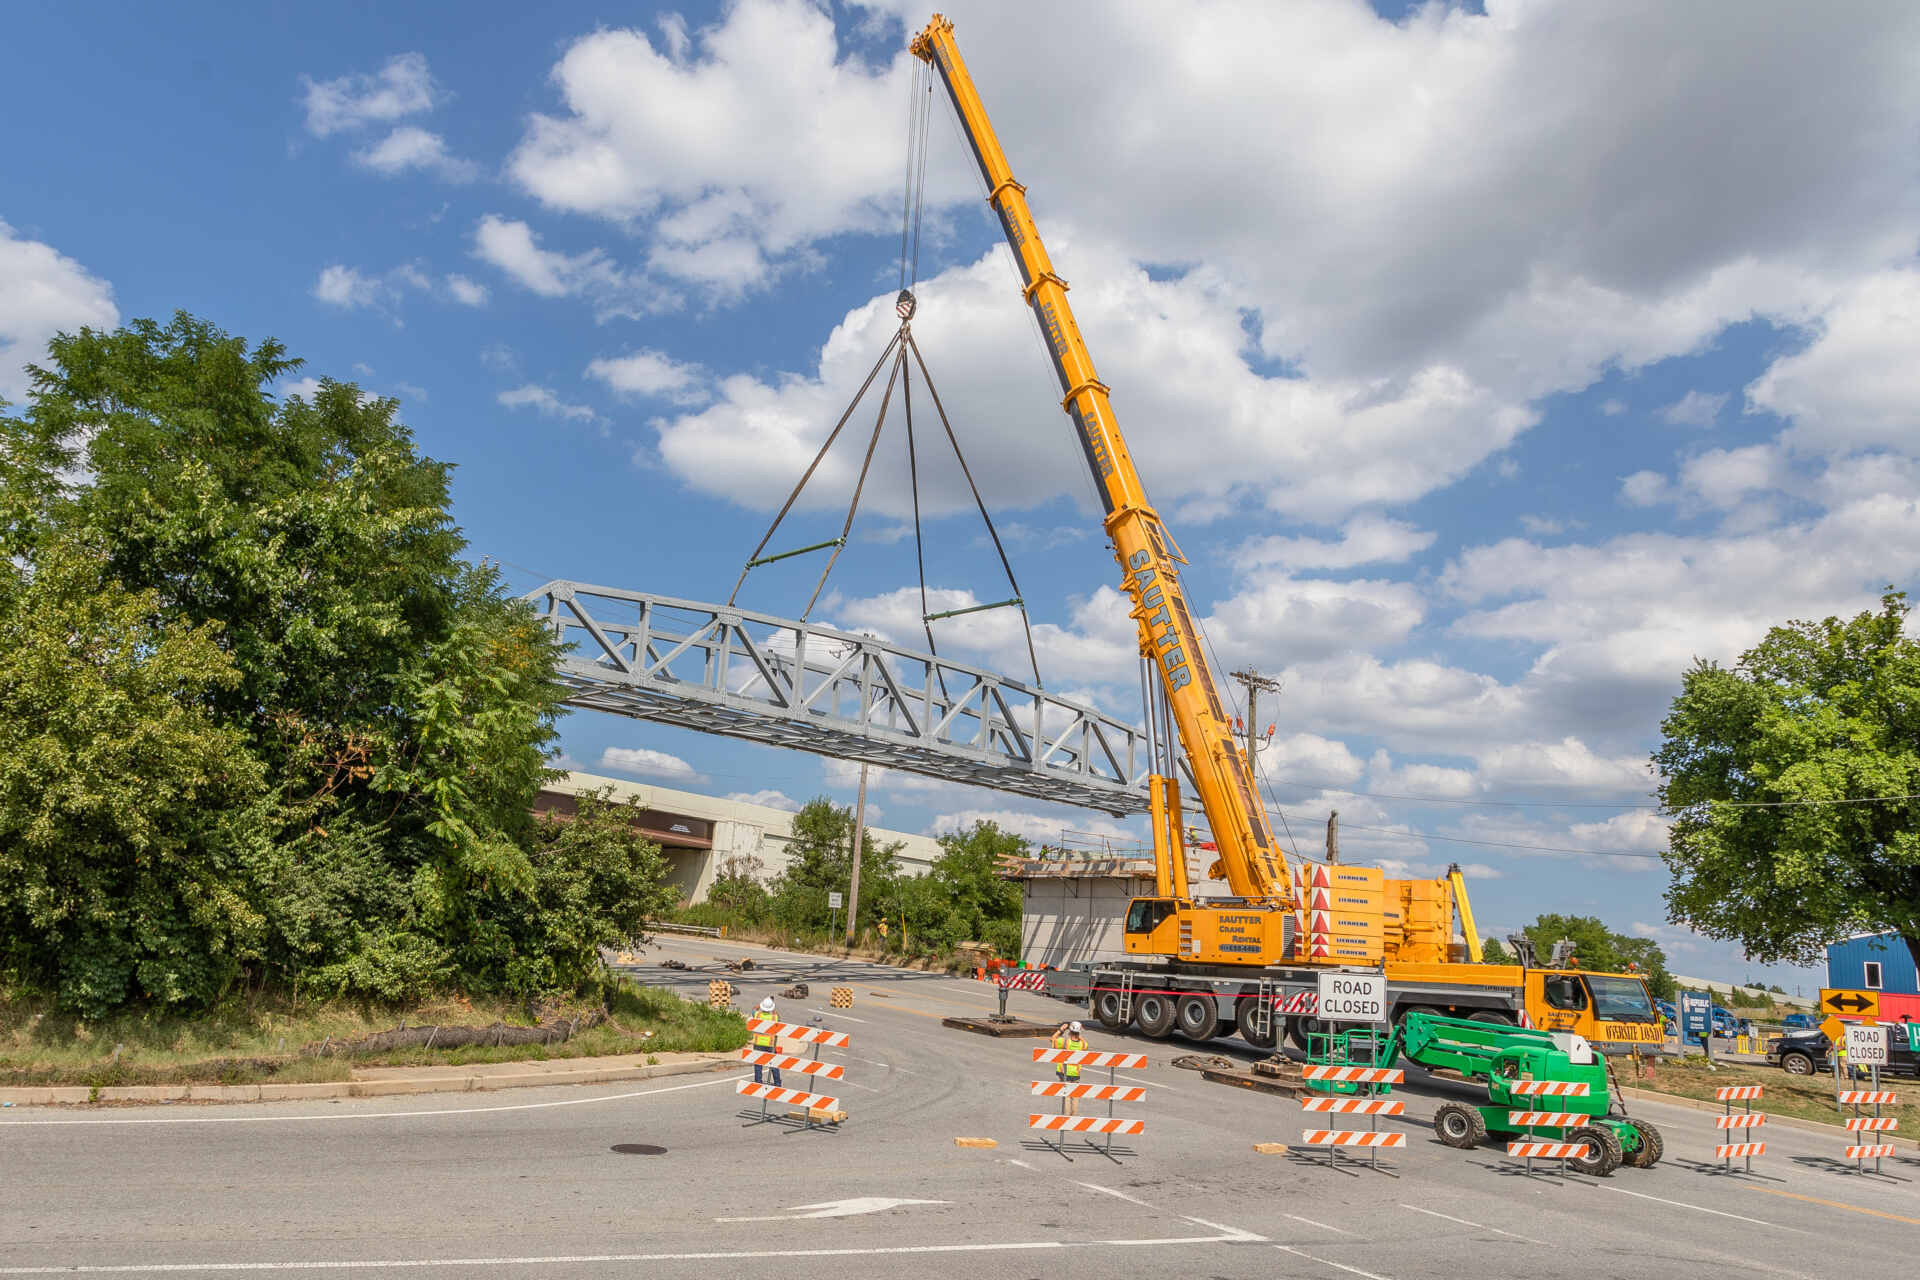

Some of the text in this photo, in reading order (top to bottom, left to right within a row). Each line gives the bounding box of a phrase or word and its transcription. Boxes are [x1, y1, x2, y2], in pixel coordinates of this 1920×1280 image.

[1083, 411, 1113, 479] SAUTTER
[1129, 549, 1191, 693] SAUTTER
[1219, 915, 1261, 924] SAUTTER
[1333, 980, 1372, 995] ROAD
[1324, 999, 1380, 1015] CLOSED
[1605, 1024, 1661, 1041] OVERSIZE LOAD
[1853, 1030, 1879, 1043] ROAD
[1849, 1046, 1885, 1060] CLOSED
